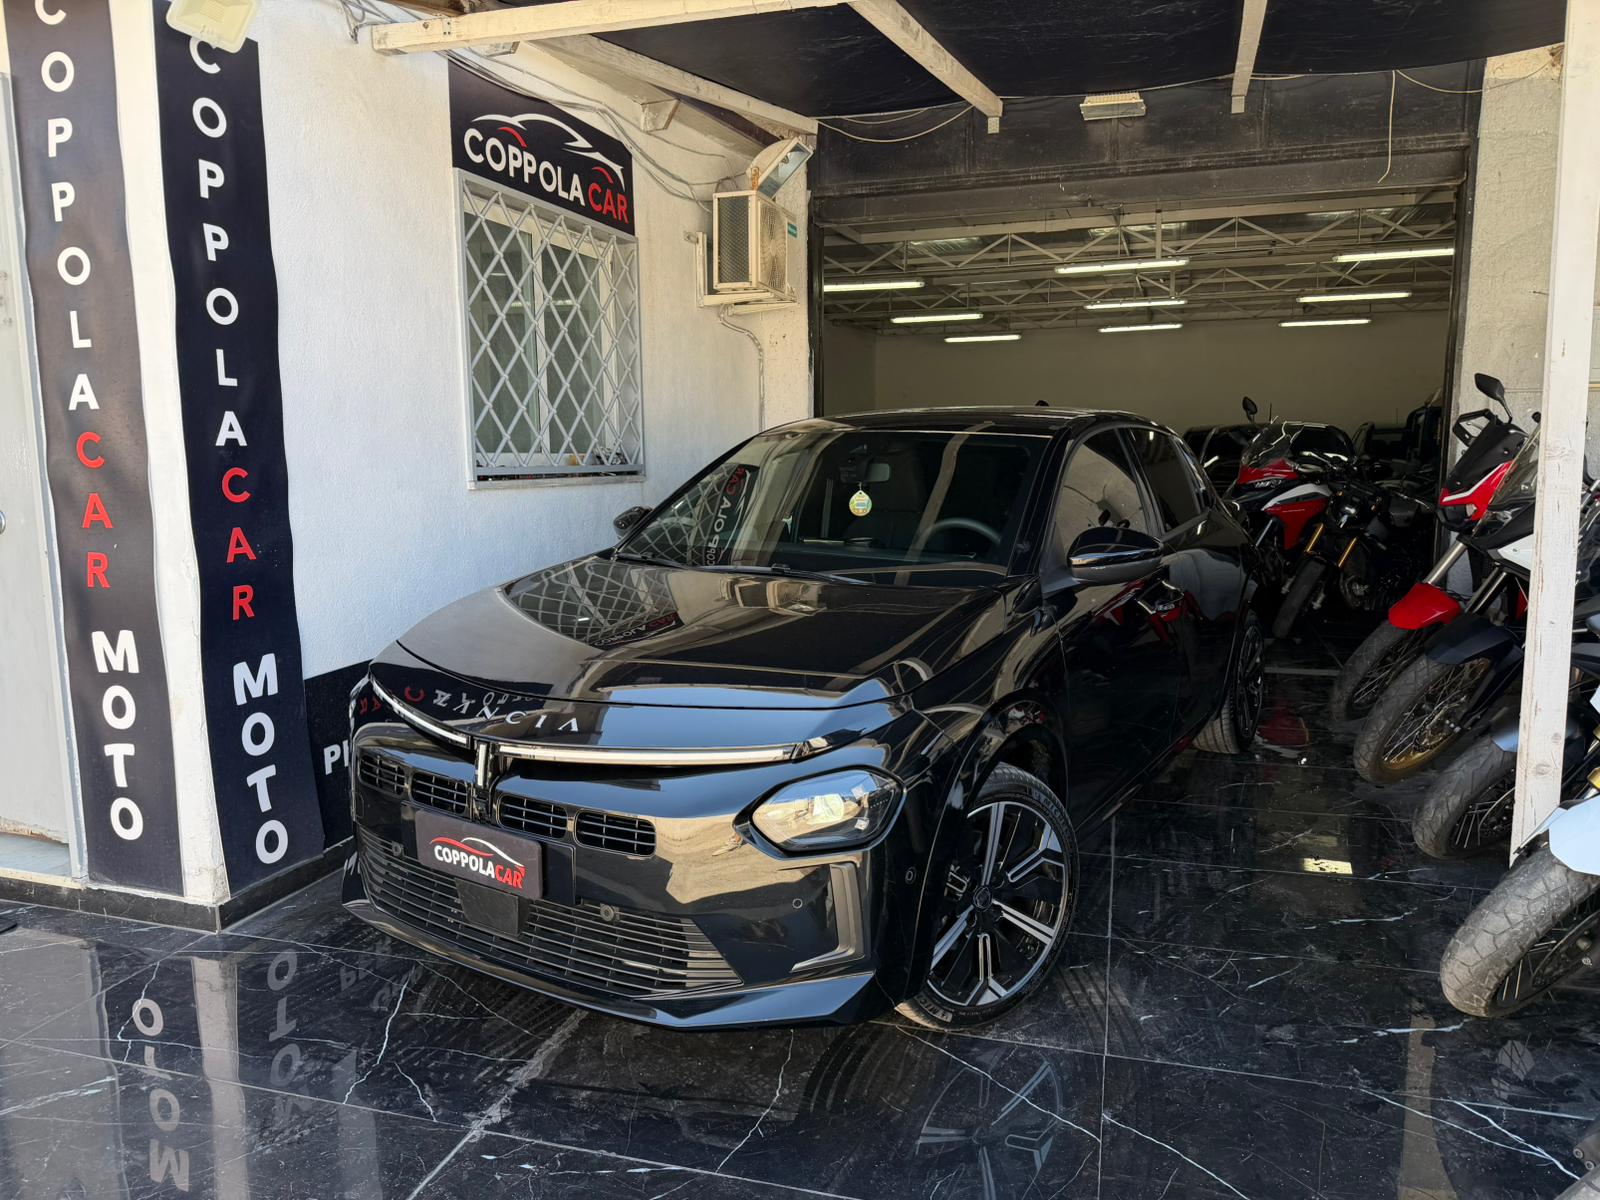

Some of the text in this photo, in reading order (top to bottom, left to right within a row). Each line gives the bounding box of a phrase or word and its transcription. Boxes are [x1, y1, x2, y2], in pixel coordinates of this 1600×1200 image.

[463, 128, 629, 223] COPPOLA CAR
[91, 629, 144, 841] MOTO
[233, 653, 289, 865] MOTO
